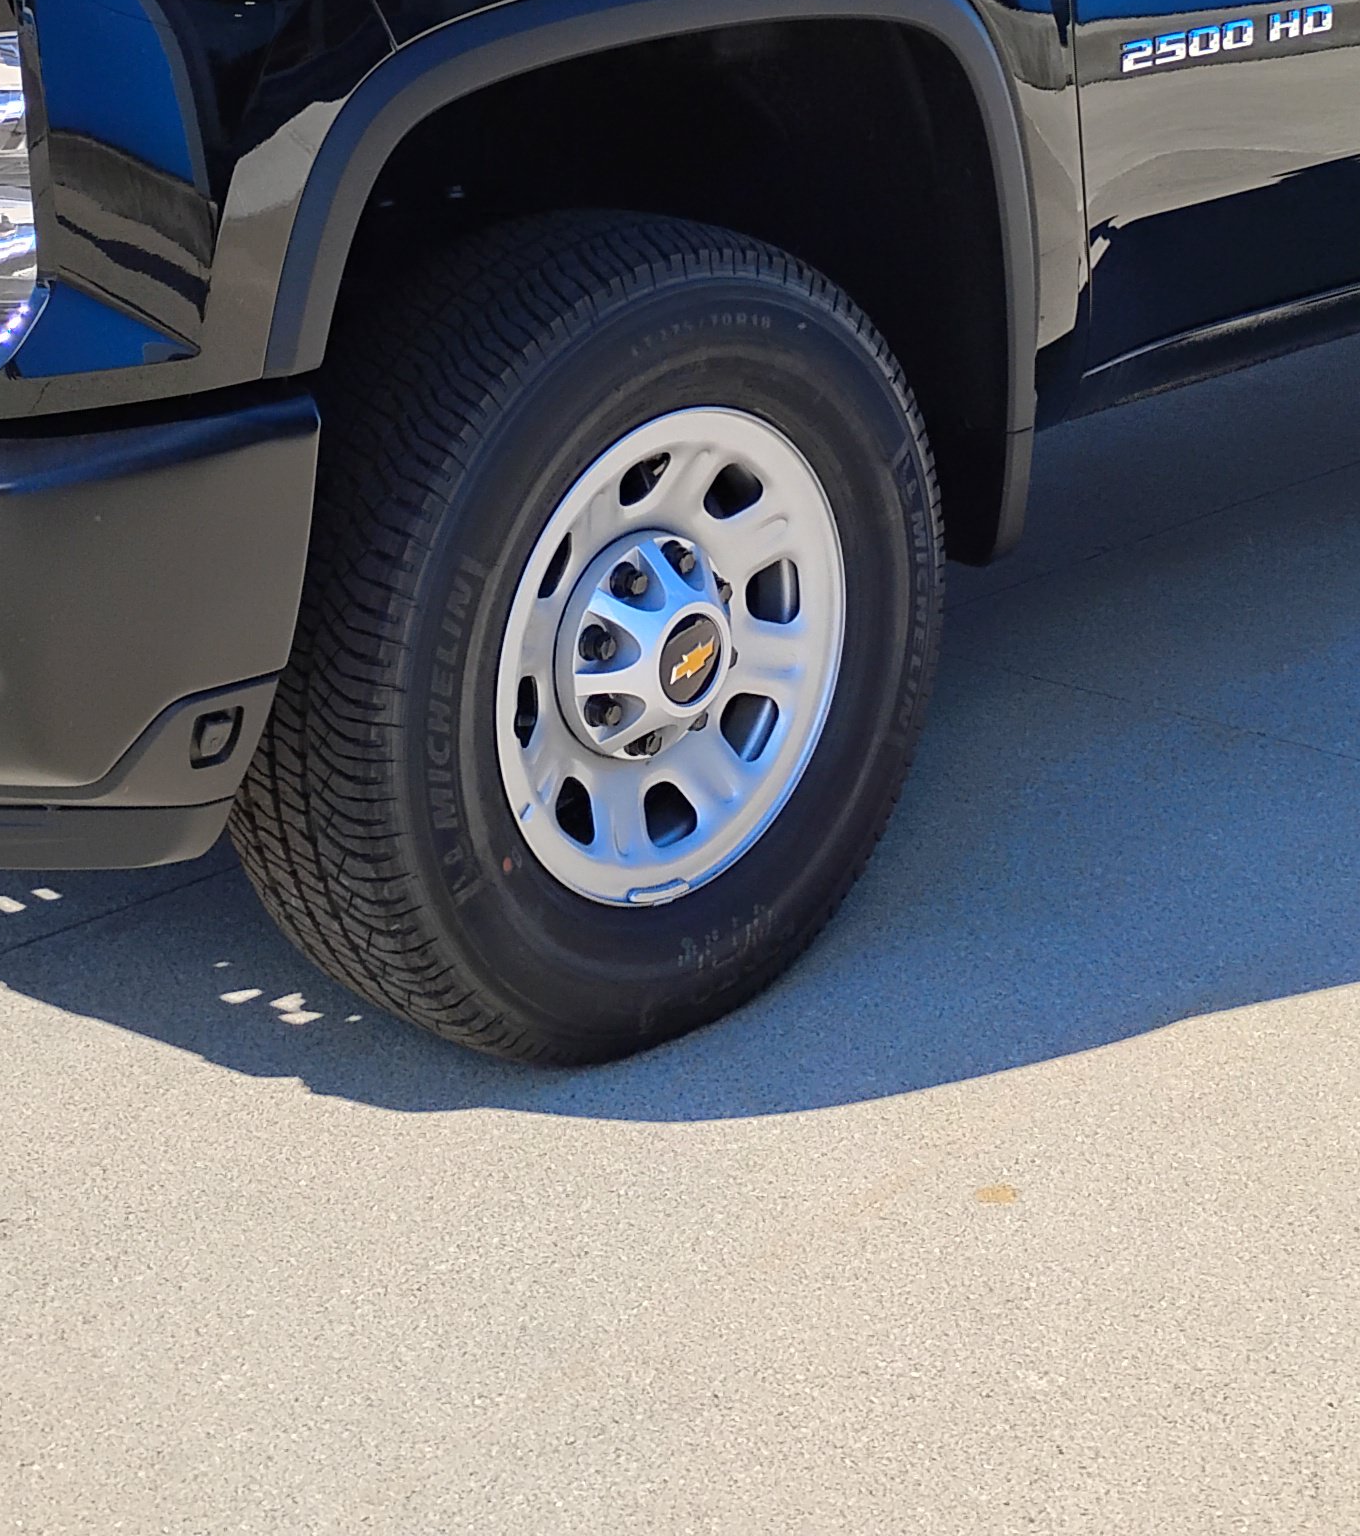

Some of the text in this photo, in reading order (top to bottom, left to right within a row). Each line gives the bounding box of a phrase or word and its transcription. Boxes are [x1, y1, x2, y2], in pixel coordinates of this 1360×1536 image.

[1120, 3, 1333, 73] 2500 HD
[426, 574, 474, 831] MICHELIN
